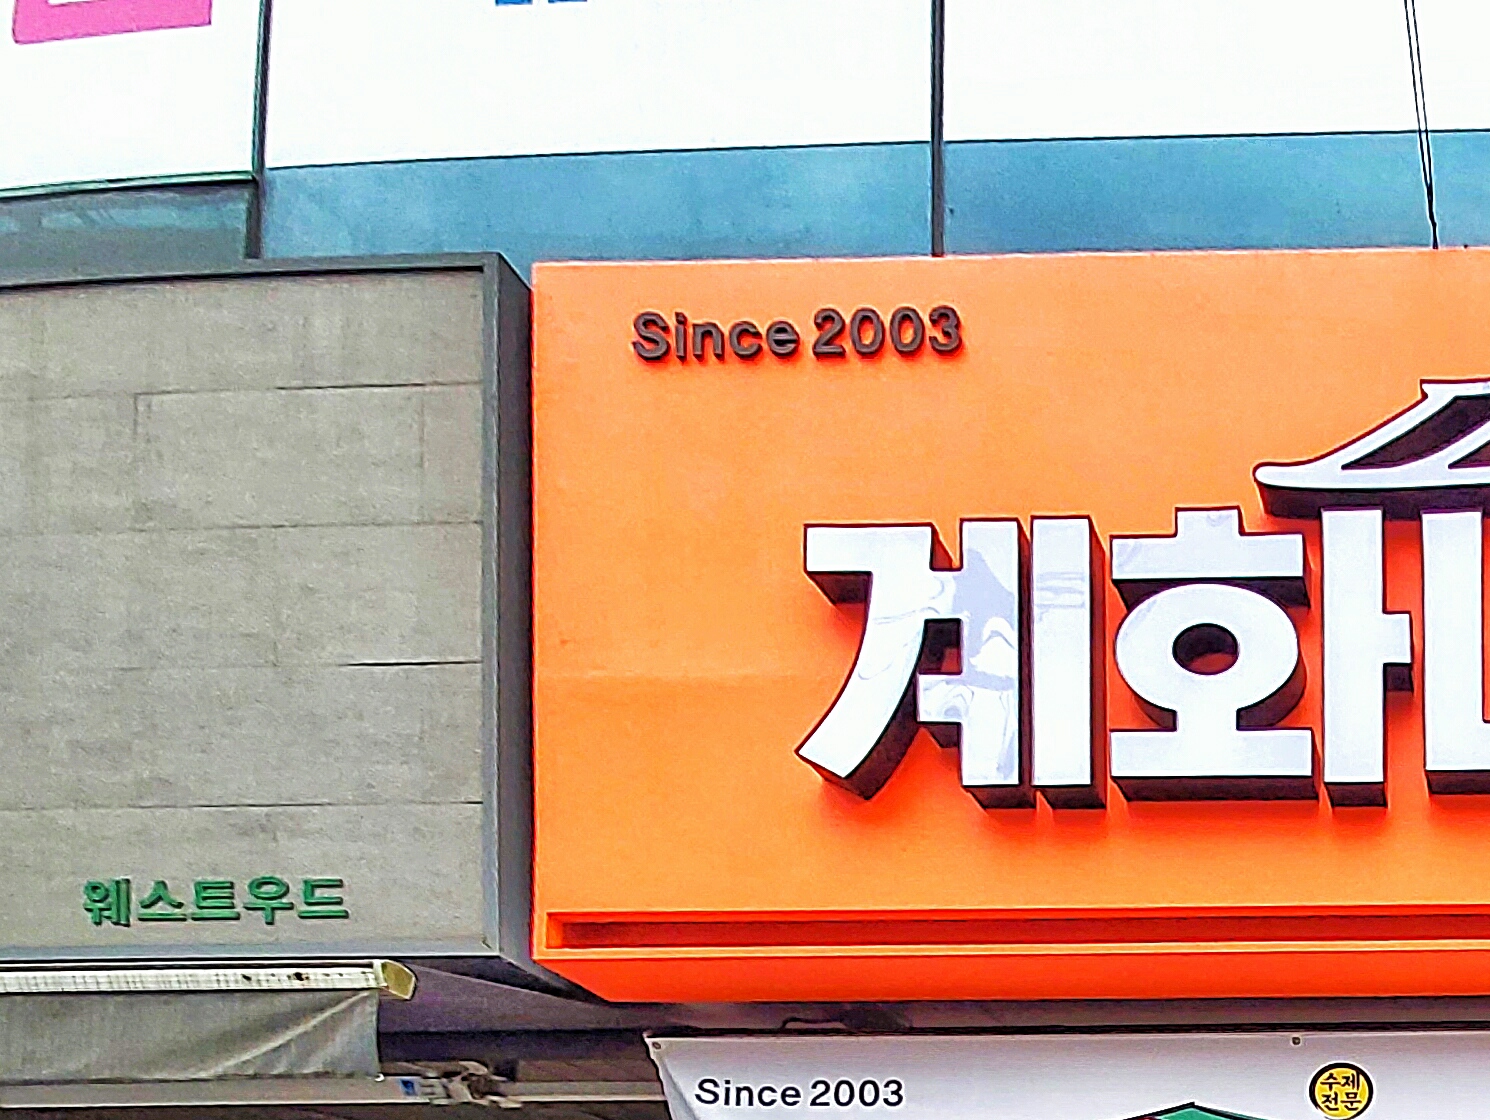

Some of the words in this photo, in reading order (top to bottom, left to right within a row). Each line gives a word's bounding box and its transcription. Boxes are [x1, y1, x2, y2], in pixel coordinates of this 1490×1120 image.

[632, 309, 800, 362] Since
[812, 304, 964, 360] 2003
[83, 876, 349, 928] 웨스트우드
[694, 1077, 801, 1108] Since
[810, 1078, 905, 1108] 2003
[1320, 1072, 1360, 1091] 수제
[1321, 1091, 1362, 1111] 전문
